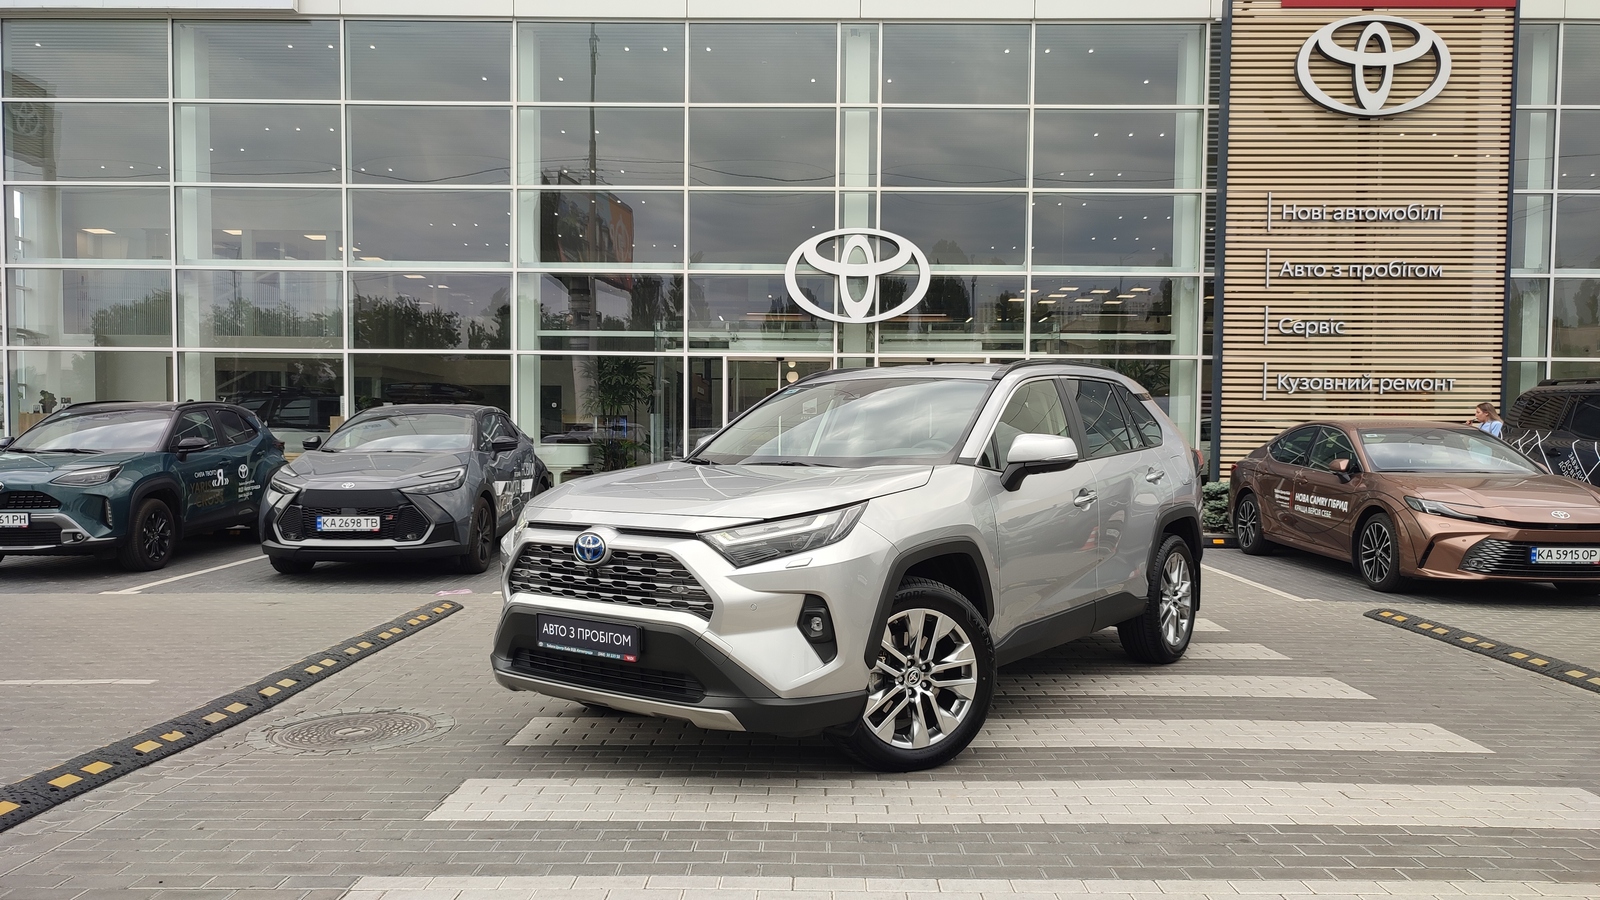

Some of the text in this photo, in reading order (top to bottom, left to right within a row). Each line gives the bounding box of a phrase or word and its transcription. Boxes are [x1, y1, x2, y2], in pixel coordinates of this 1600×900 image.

[1281, 203, 1444, 221] Нові автомобілі
[1279, 259, 1444, 282] Авто з пробігом
[1278, 317, 1346, 338] Сервіс
[1277, 373, 1457, 395] Кузовний ремонт
[1564, 459, 1579, 480] ДОВЕ
[190, 480, 213, 494] YARIS
[338, 517, 362, 528] 2698
[1555, 549, 1580, 560] 5915
[542, 622, 567, 637] АВТО
[577, 627, 632, 647] ПРОБІГОМ
